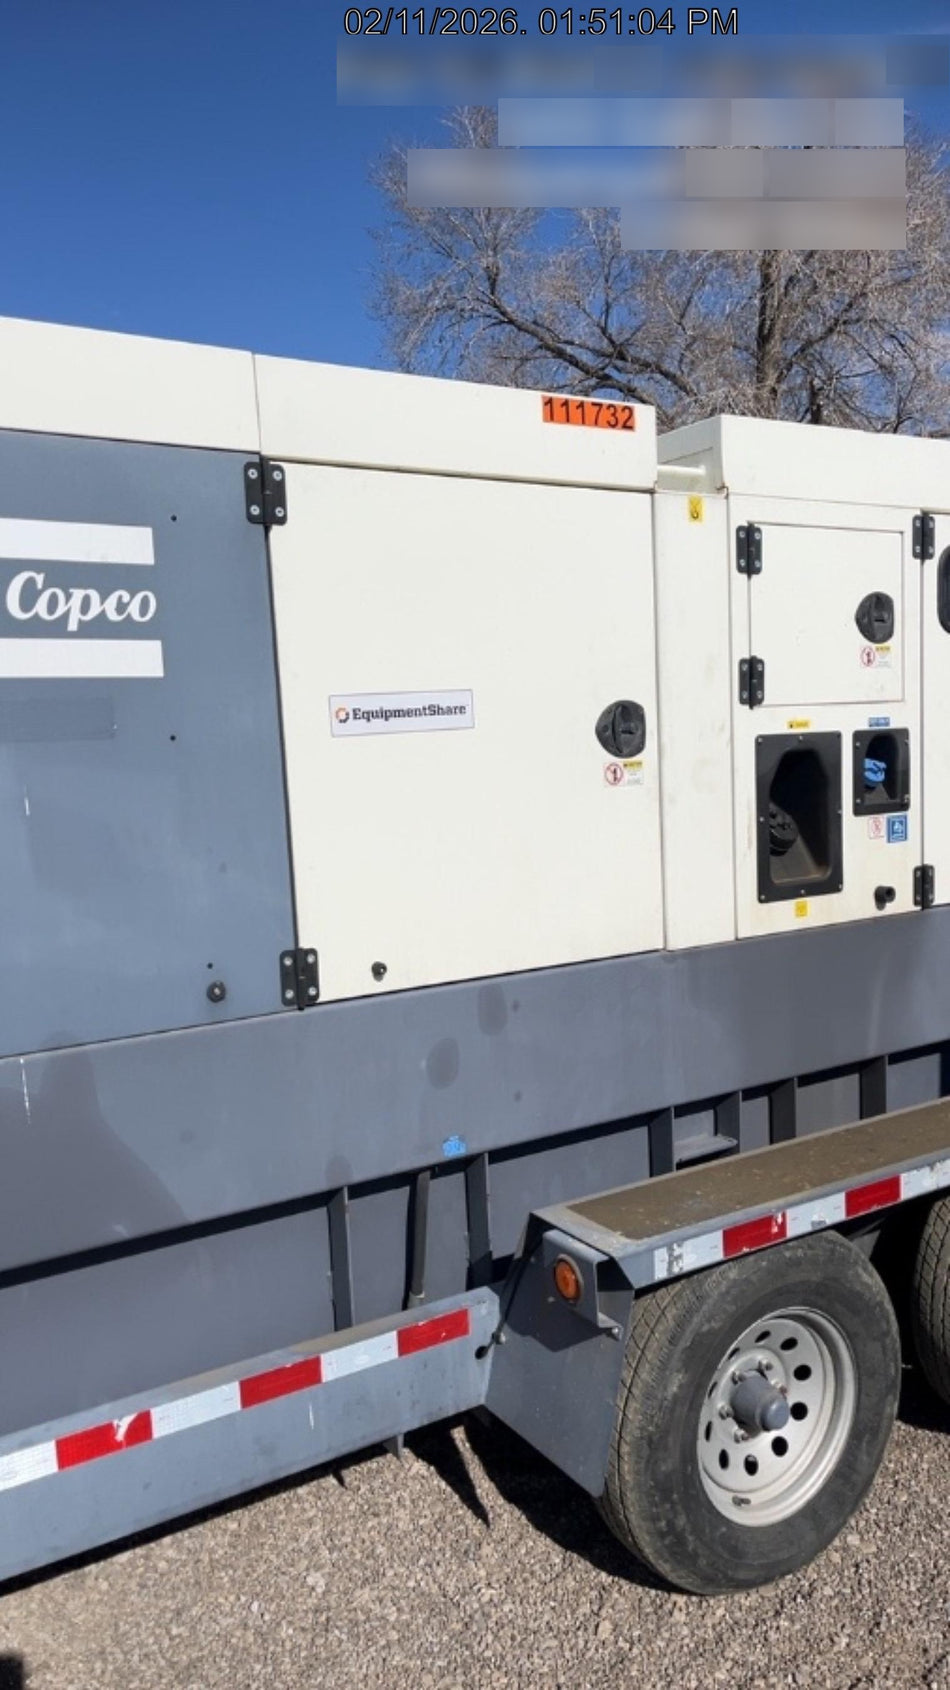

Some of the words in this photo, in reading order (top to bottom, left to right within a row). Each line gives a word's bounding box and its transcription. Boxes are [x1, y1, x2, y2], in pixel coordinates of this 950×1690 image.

[543, 397, 634, 429] 111732
[6, 570, 157, 631] Copco
[352, 704, 467, 722] EquipmentShare
